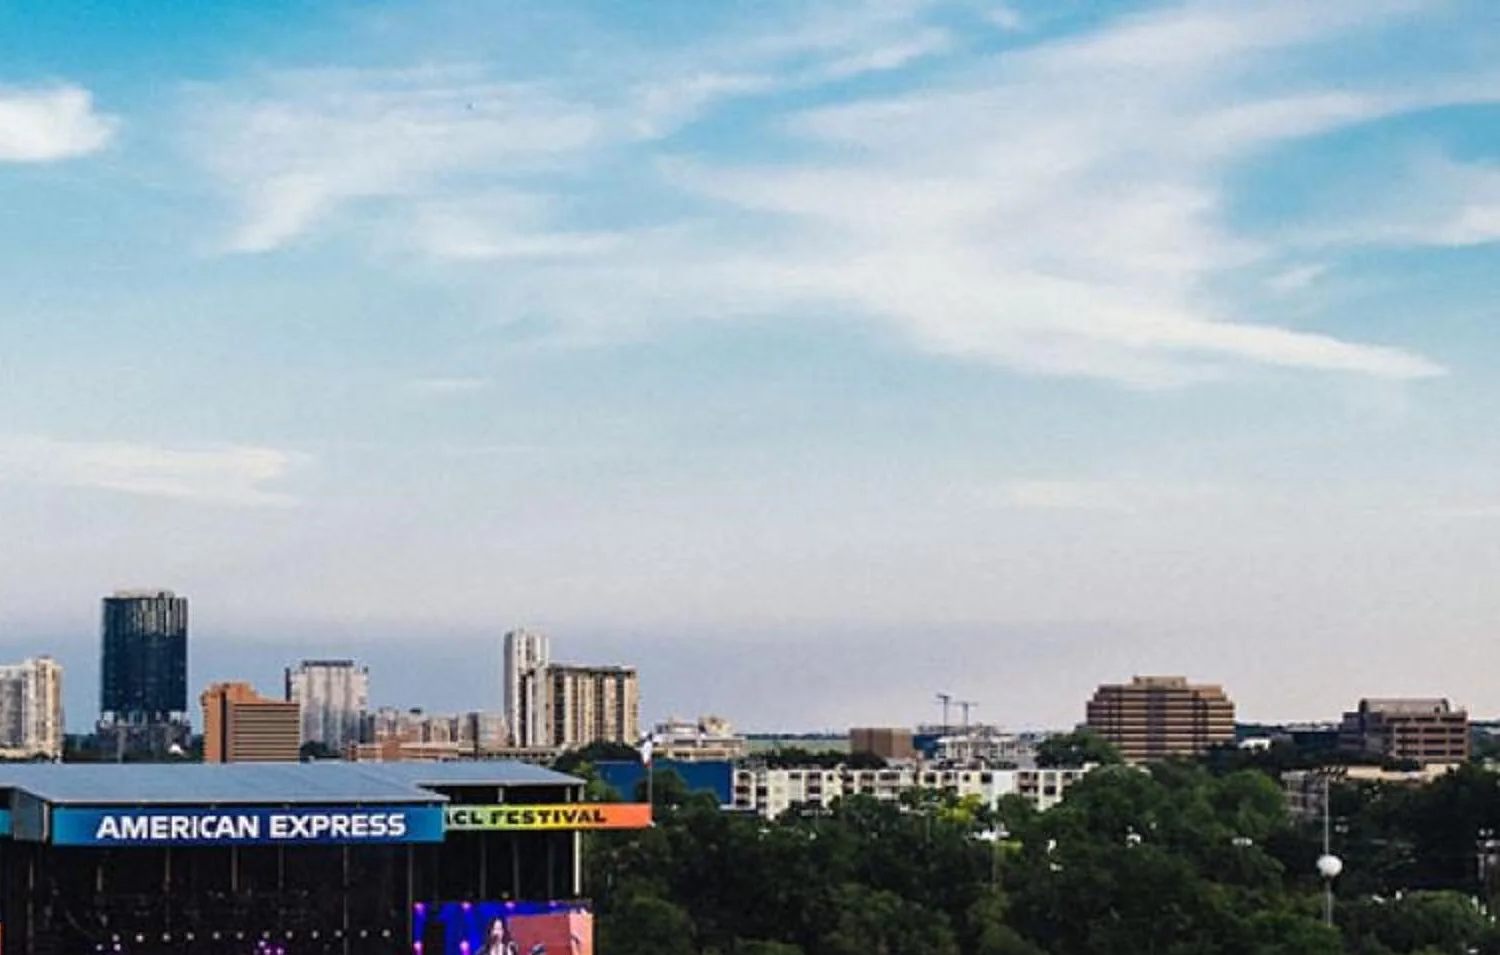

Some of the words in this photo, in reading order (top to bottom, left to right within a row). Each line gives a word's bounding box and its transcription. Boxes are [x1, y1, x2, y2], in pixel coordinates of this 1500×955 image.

[96, 814, 260, 839] AMERICAN
[268, 813, 407, 838] EXPRESS
[490, 809, 607, 825] FESTIVAL
